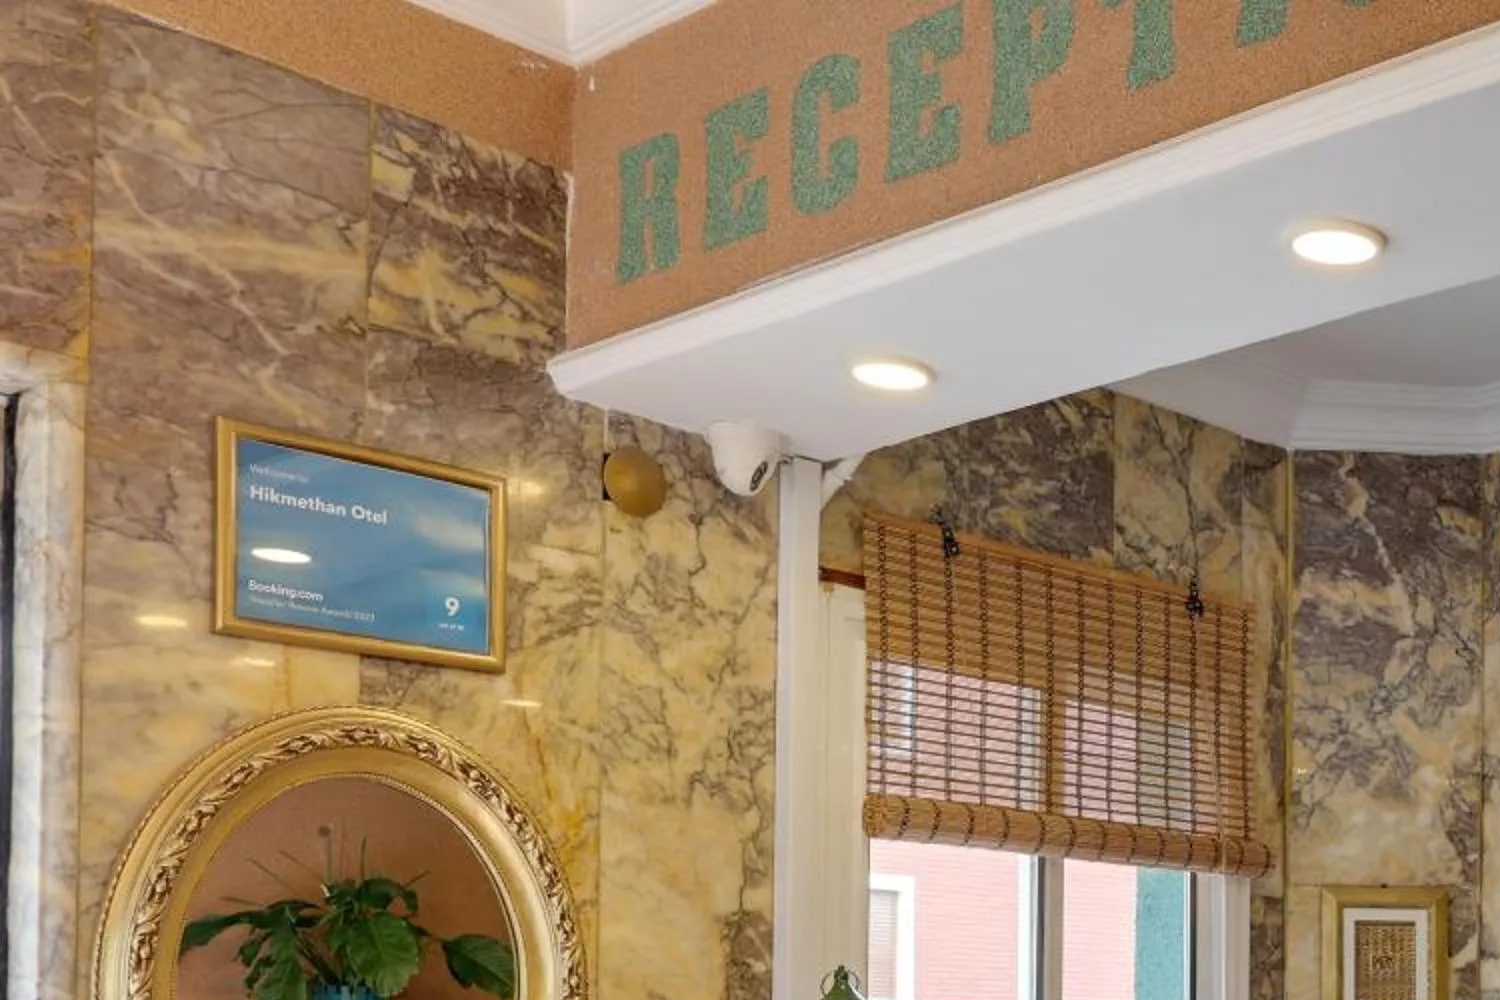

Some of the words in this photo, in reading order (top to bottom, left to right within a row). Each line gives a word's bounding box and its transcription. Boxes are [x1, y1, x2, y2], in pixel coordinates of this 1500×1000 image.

[616, 0, 1377, 285] RECEPT
[249, 485, 347, 517] Hikmethan
[351, 505, 387, 525] Otel
[248, 579, 324, 602] Booking.com
[445, 597, 460, 617] 9
